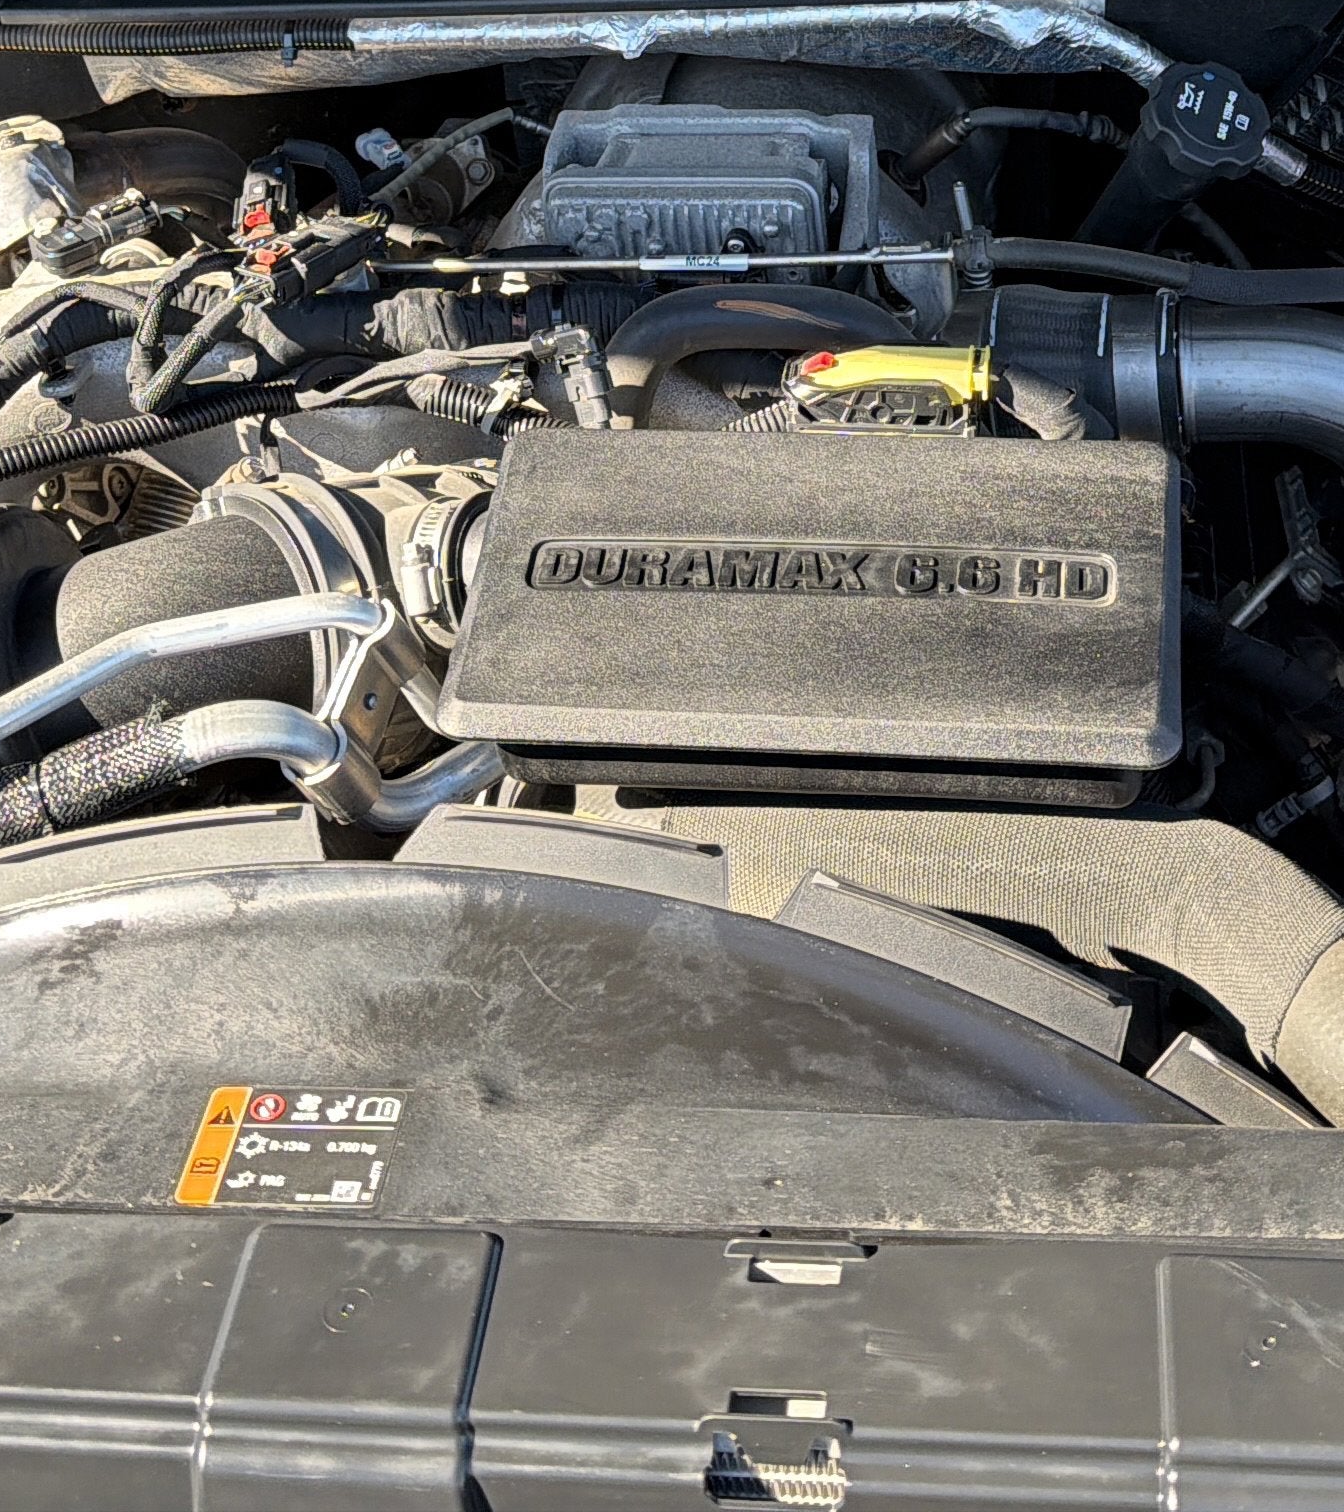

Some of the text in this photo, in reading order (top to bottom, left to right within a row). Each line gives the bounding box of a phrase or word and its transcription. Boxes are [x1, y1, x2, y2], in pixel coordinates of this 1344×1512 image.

[685, 255, 720, 267] MC24
[543, 547, 1108, 600] DURAMAX 6.6 HD
[268, 1139, 311, 1153] R-134a
